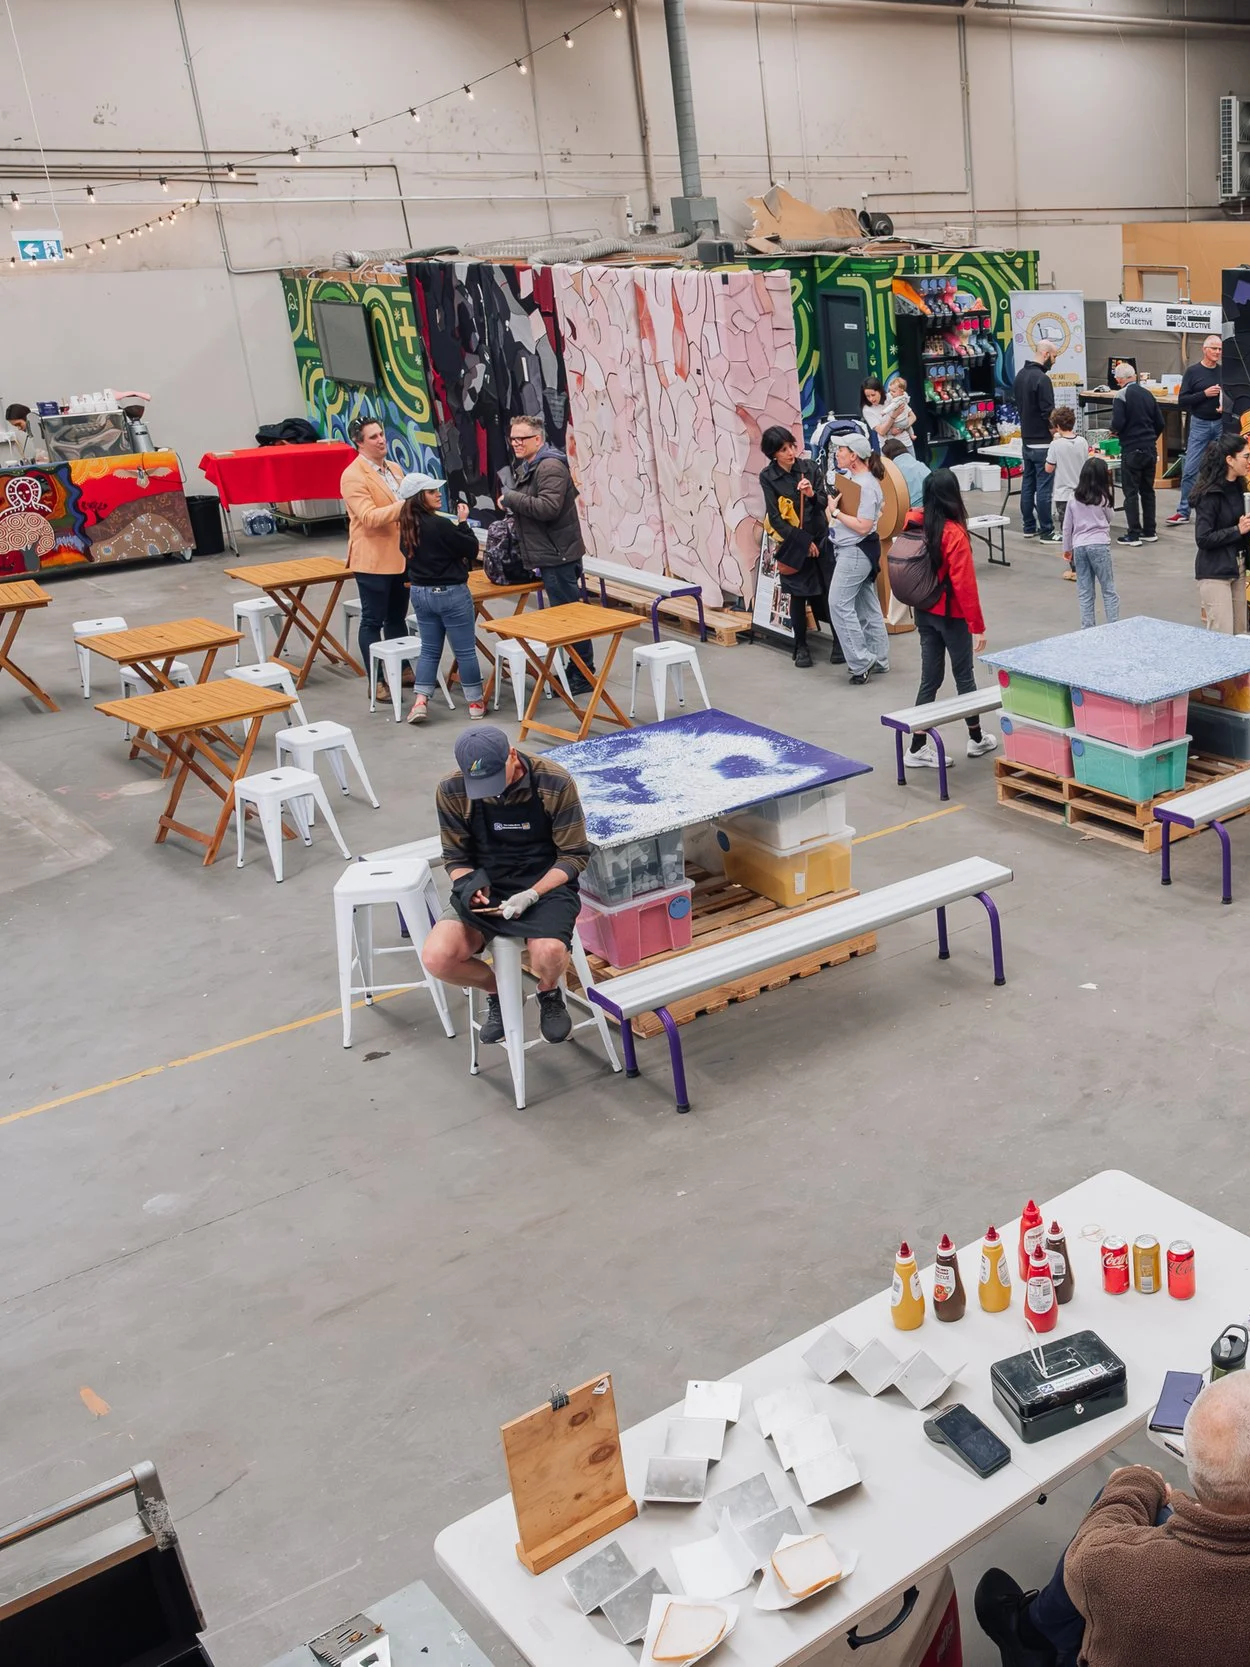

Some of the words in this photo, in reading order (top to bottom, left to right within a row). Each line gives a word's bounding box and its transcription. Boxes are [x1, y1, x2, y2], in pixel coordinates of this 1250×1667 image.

[1182, 308, 1212, 316] CIRCULAR
[1120, 318, 1153, 326] COLLECTIVE
[1177, 321, 1212, 329] COLLECTIVE
